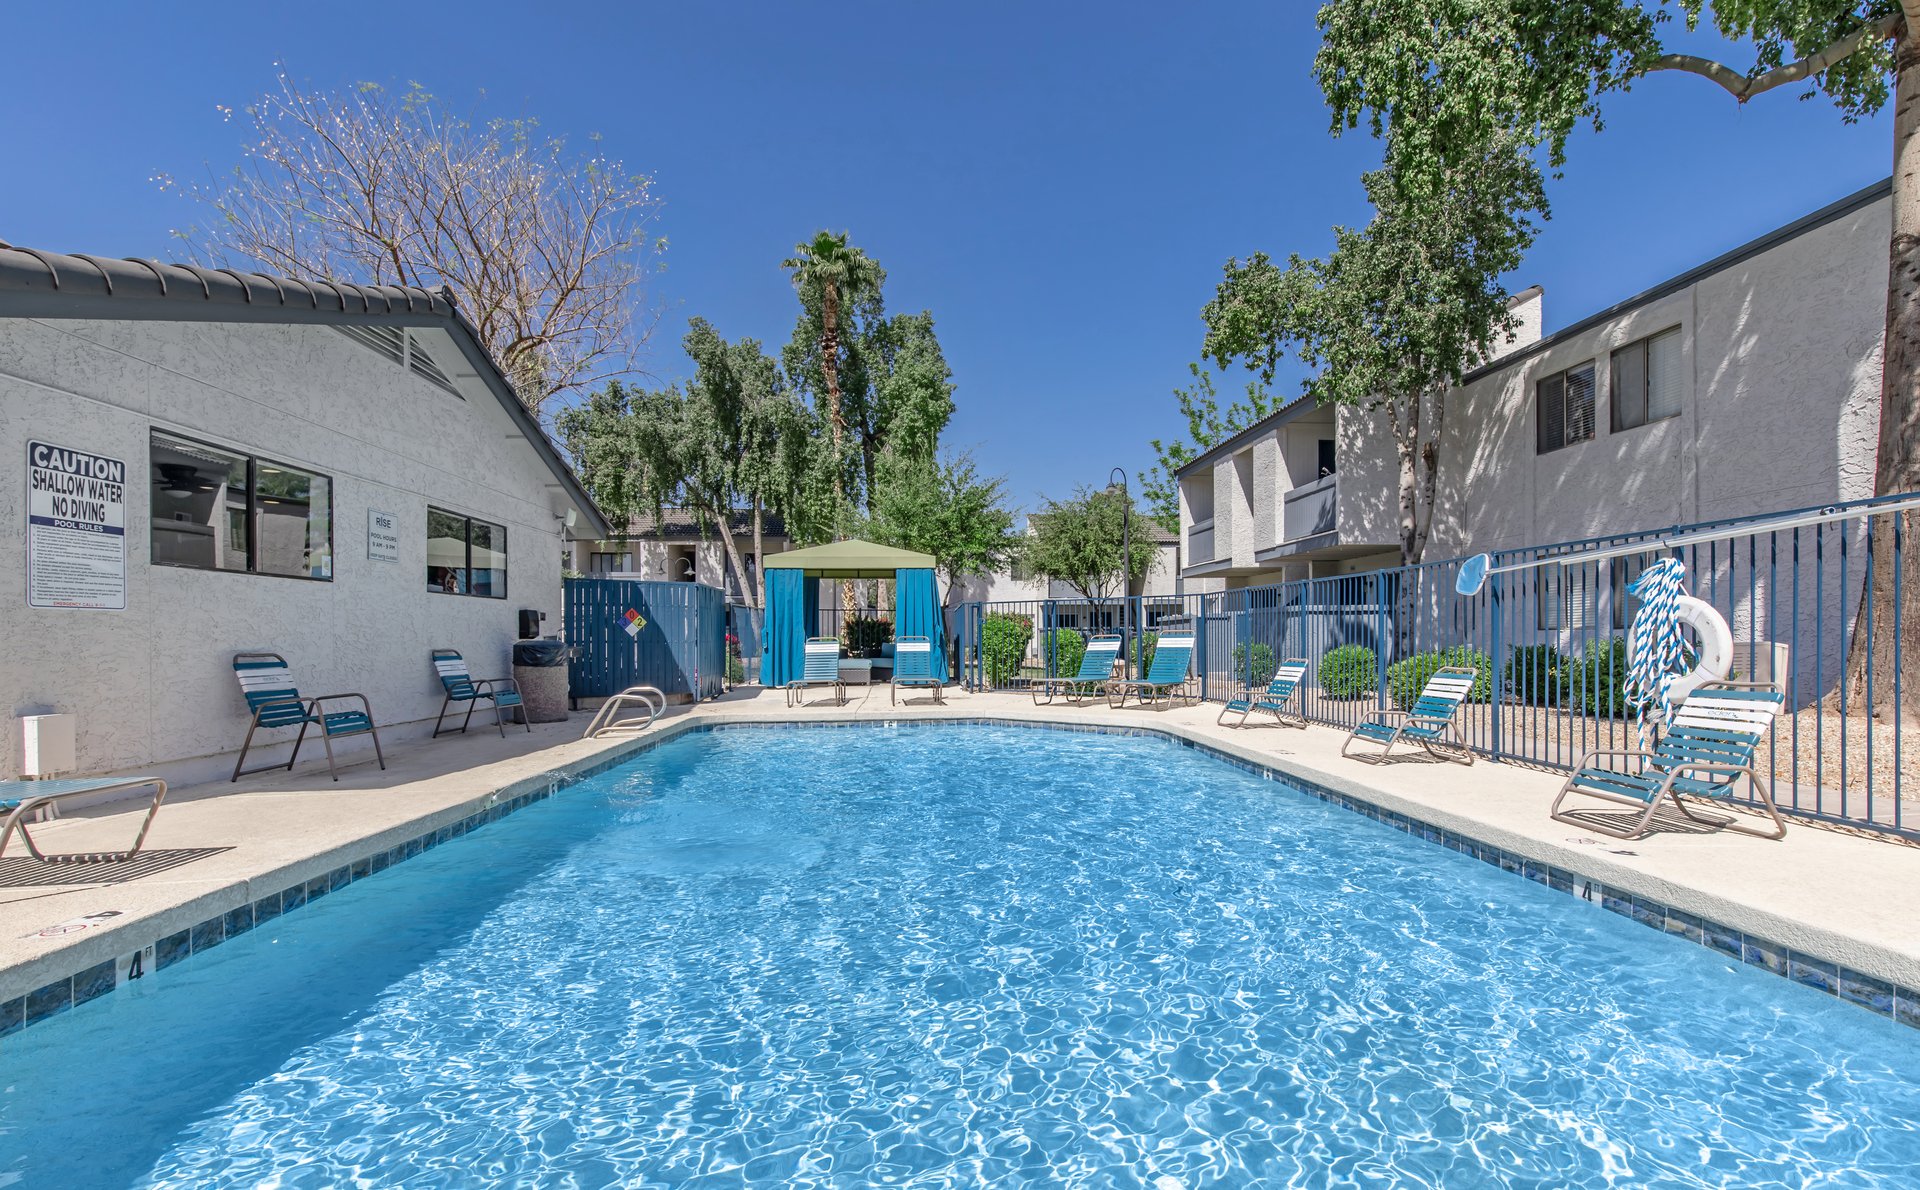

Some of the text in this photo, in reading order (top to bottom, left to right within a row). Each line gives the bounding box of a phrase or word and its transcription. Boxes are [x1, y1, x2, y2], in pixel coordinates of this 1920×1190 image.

[34, 445, 122, 482] CAUTION
[32, 468, 123, 504] SHALLOW WATER
[52, 495, 105, 522] NO DIVING
[54, 520, 104, 532] POOL RULES
[376, 516, 391, 528] RISE
[630, 610, 634, 619] 0
[637, 618, 643, 626] 2
[1582, 880, 1593, 902] 4
[128, 945, 153, 980] 4 FT
